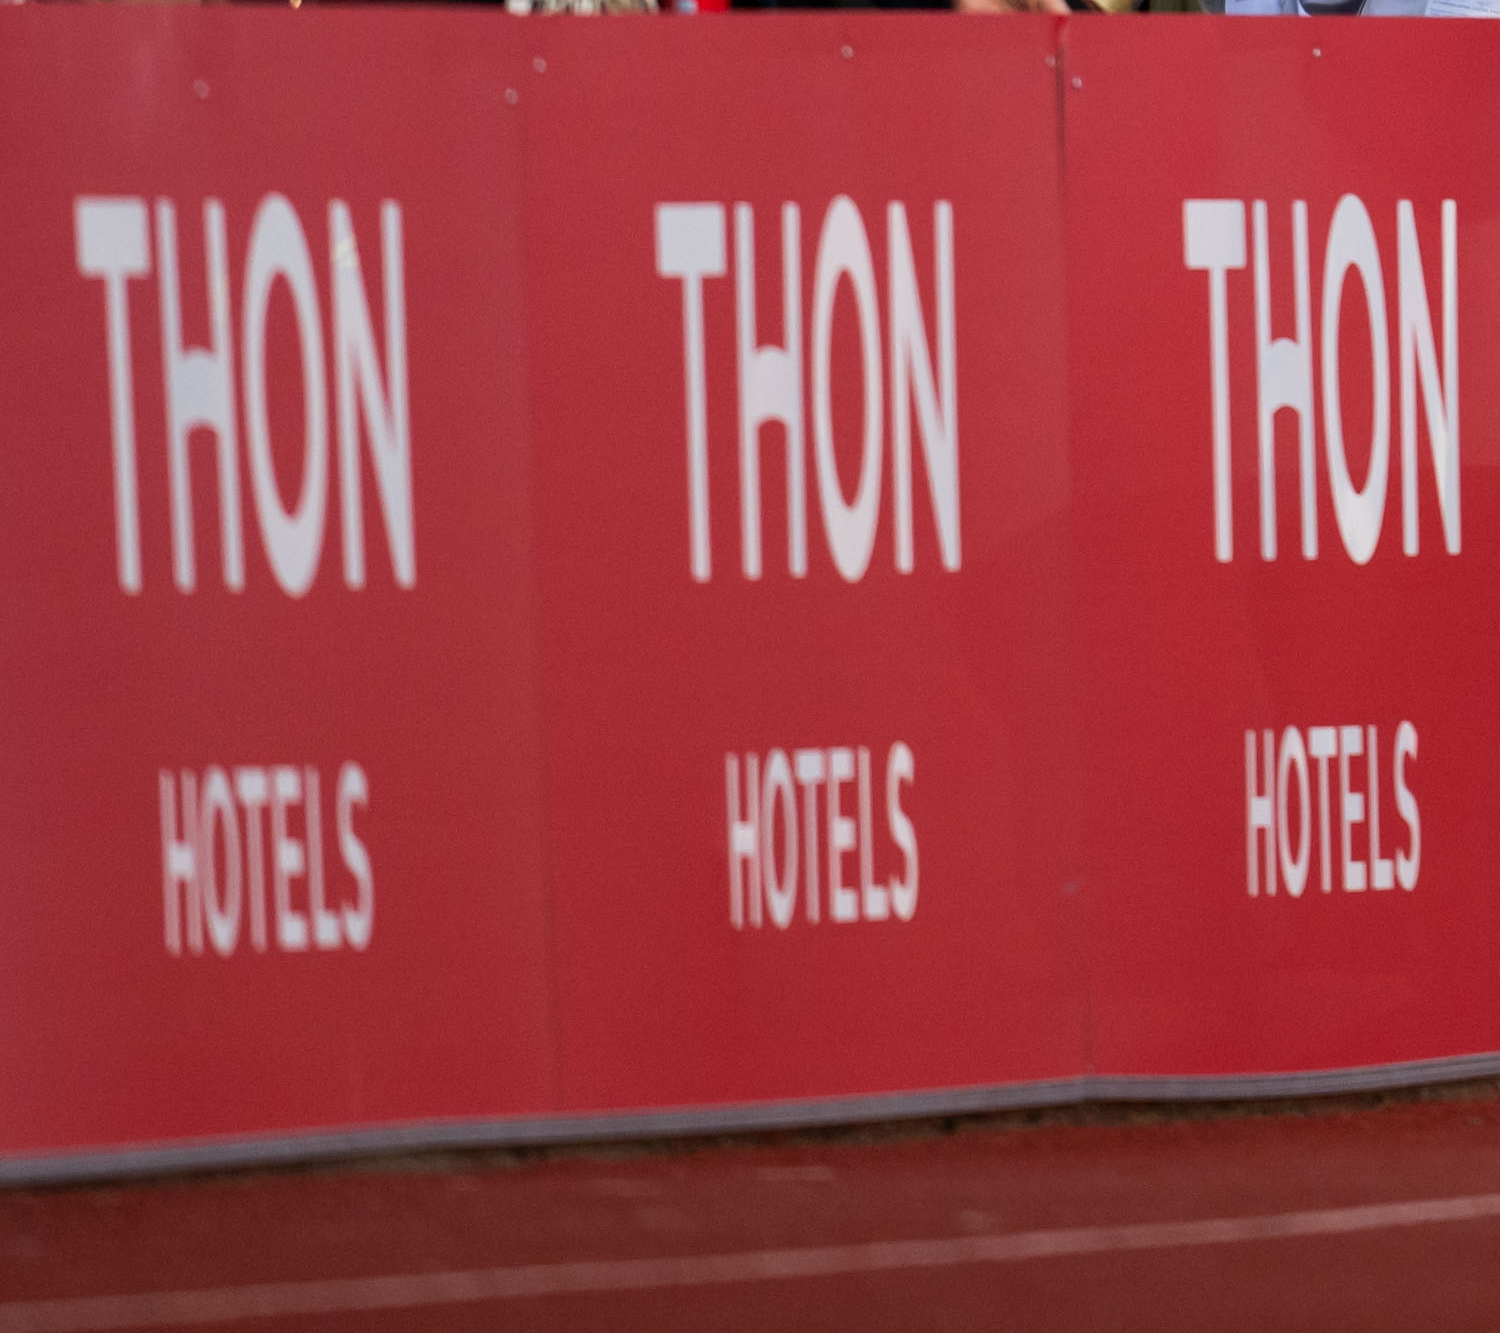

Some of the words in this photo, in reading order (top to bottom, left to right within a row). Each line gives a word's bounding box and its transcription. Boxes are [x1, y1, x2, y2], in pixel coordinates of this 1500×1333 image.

[73, 191, 417, 599] THON
[654, 193, 963, 584] THON
[1182, 192, 1463, 566] THON
[159, 760, 376, 957] HOTELS
[724, 740, 919, 931] HOTELS
[1244, 719, 1422, 898] HOTELS
